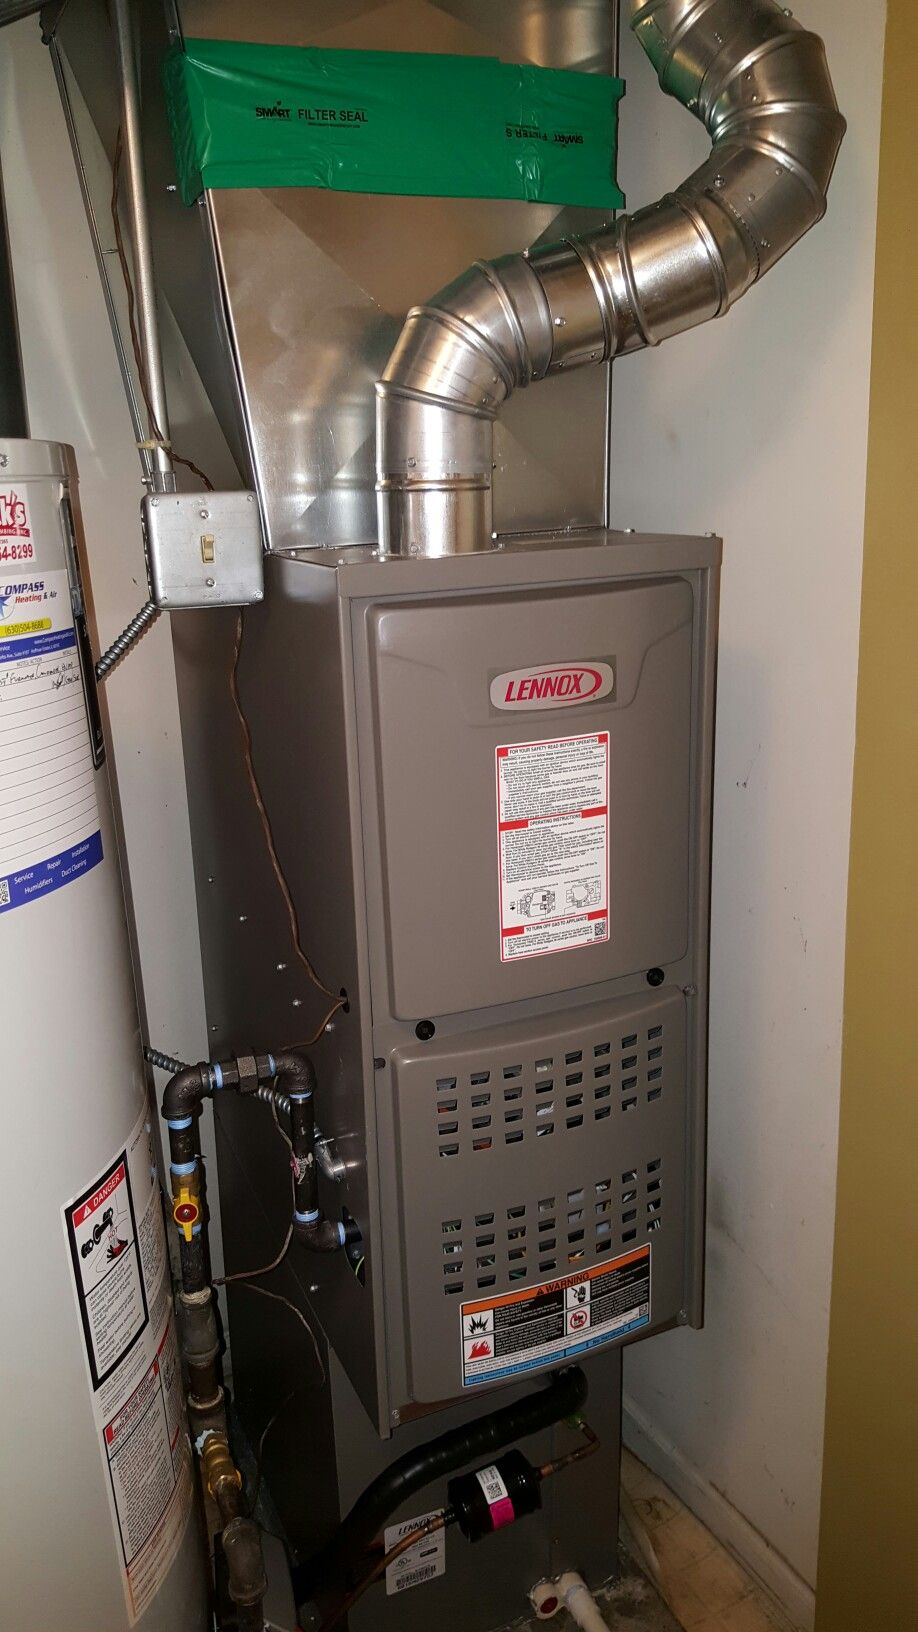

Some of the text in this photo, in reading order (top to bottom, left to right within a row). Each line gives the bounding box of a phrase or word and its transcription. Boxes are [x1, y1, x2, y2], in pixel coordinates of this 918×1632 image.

[255, 105, 369, 123] SMART FILTER SEAL
[15, 593, 42, 604] Heating
[49, 590, 57, 599] Air
[505, 673, 584, 702] LENNOX
[519, 746, 531, 754] YOUR
[531, 745, 547, 753] SAFETY
[547, 743, 559, 751] READ
[559, 741, 575, 749] BEFORE
[576, 738, 598, 747] OPERATING
[530, 814, 581, 827] OPERATING INSTRUCTIONS
[14, 872, 34, 885] Service
[46, 859, 62, 871] Repair
[24, 859, 87, 894] Humidifiers Duct Cleaning
[566, 916, 587, 926] APPLIANCE
[93, 1173, 121, 1207] DANGER
[107, 1227, 119, 1240] HOT
[546, 1272, 590, 1293] WARNING
